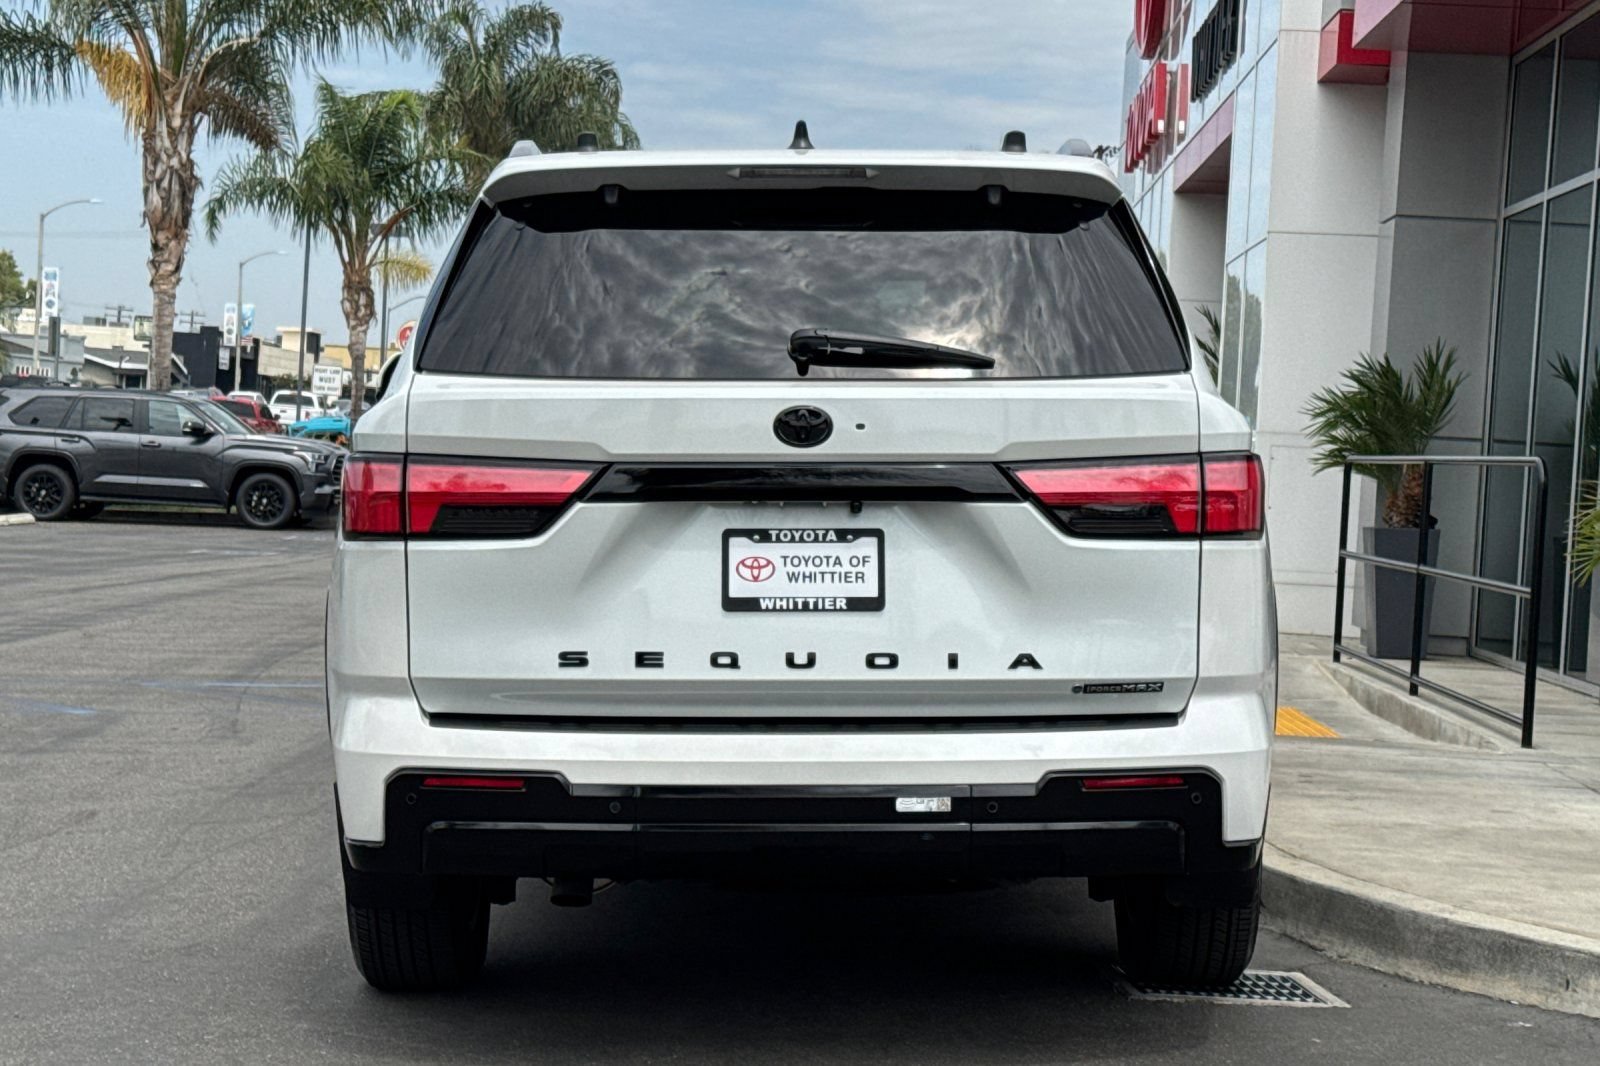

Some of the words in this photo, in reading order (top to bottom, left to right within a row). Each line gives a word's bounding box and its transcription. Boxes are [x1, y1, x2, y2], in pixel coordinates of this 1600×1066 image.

[769, 530, 837, 542] TOYOTA
[780, 555, 843, 568] TOYOTA
[848, 555, 871, 568] OF
[786, 571, 865, 584] WHITTIER
[759, 597, 848, 610] WHITTIER
[557, 650, 1044, 670] SEQUOIA
